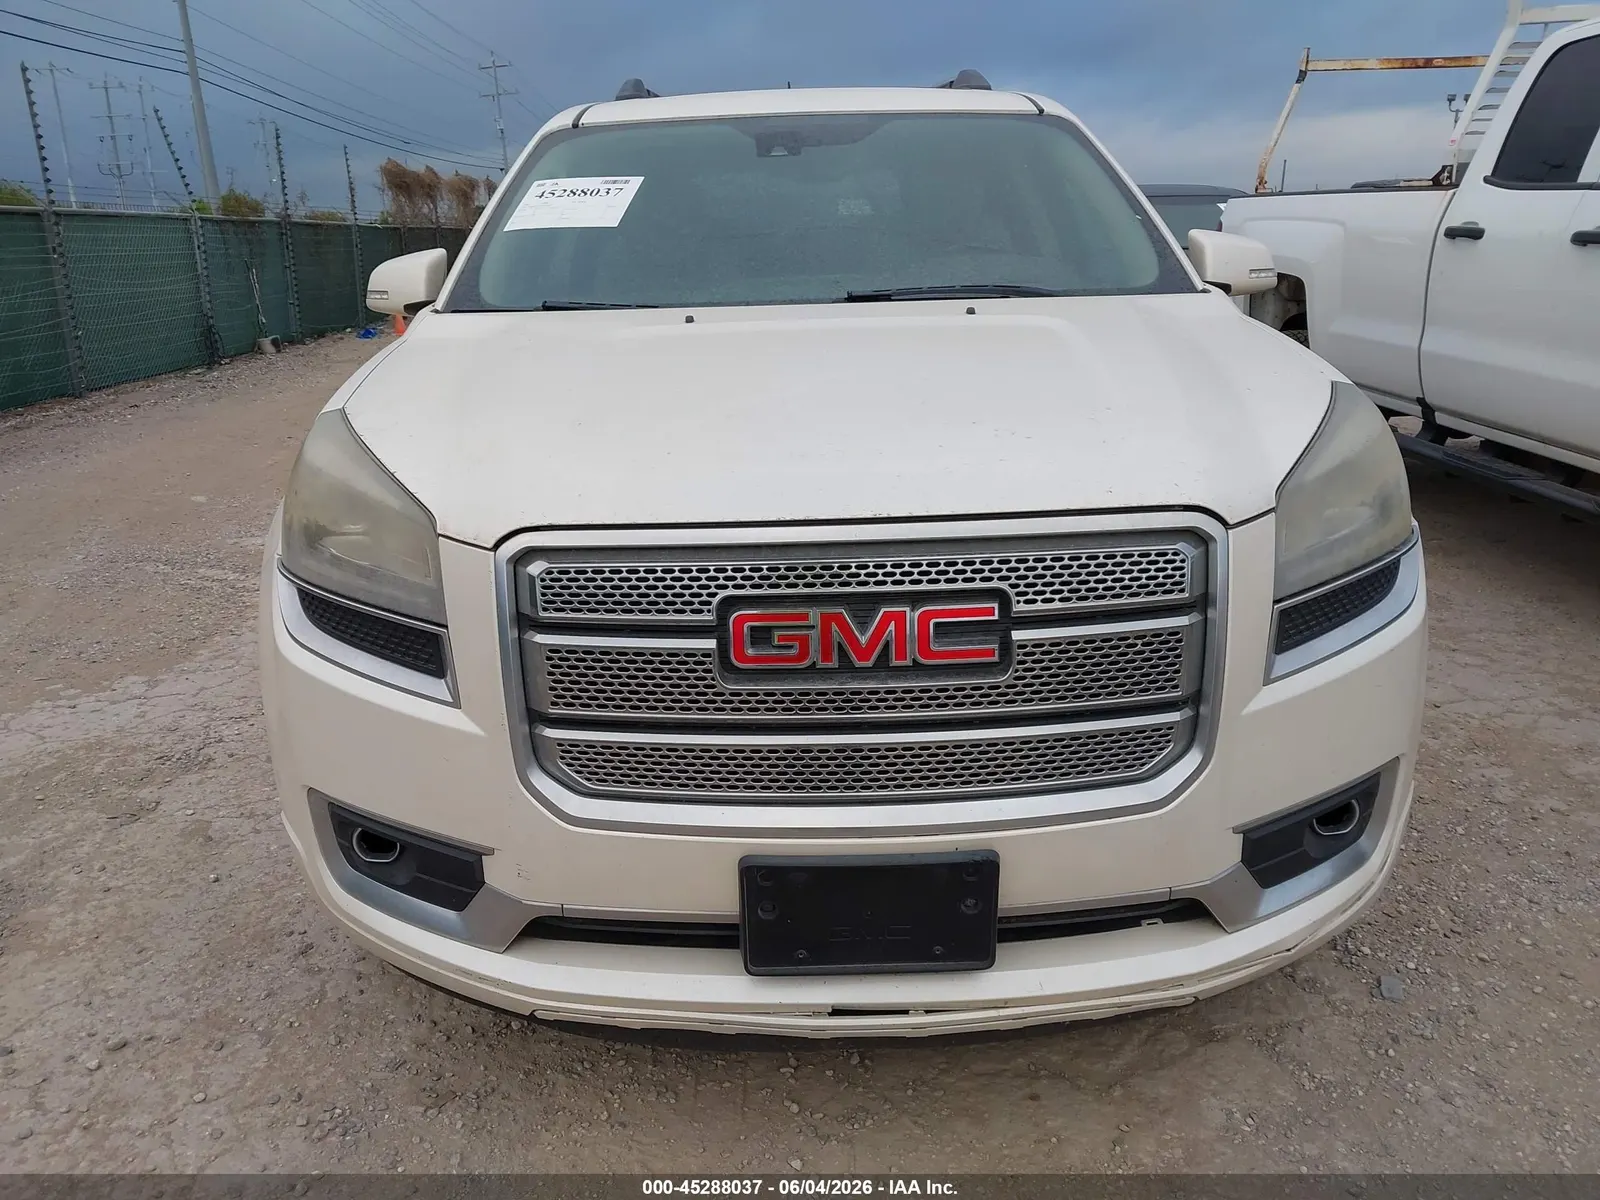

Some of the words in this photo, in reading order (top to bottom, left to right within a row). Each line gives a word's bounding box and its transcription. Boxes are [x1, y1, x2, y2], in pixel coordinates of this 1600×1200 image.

[535, 187, 624, 199] 45288037
[729, 603, 1000, 669] GMC
[829, 925, 912, 942] GMC
